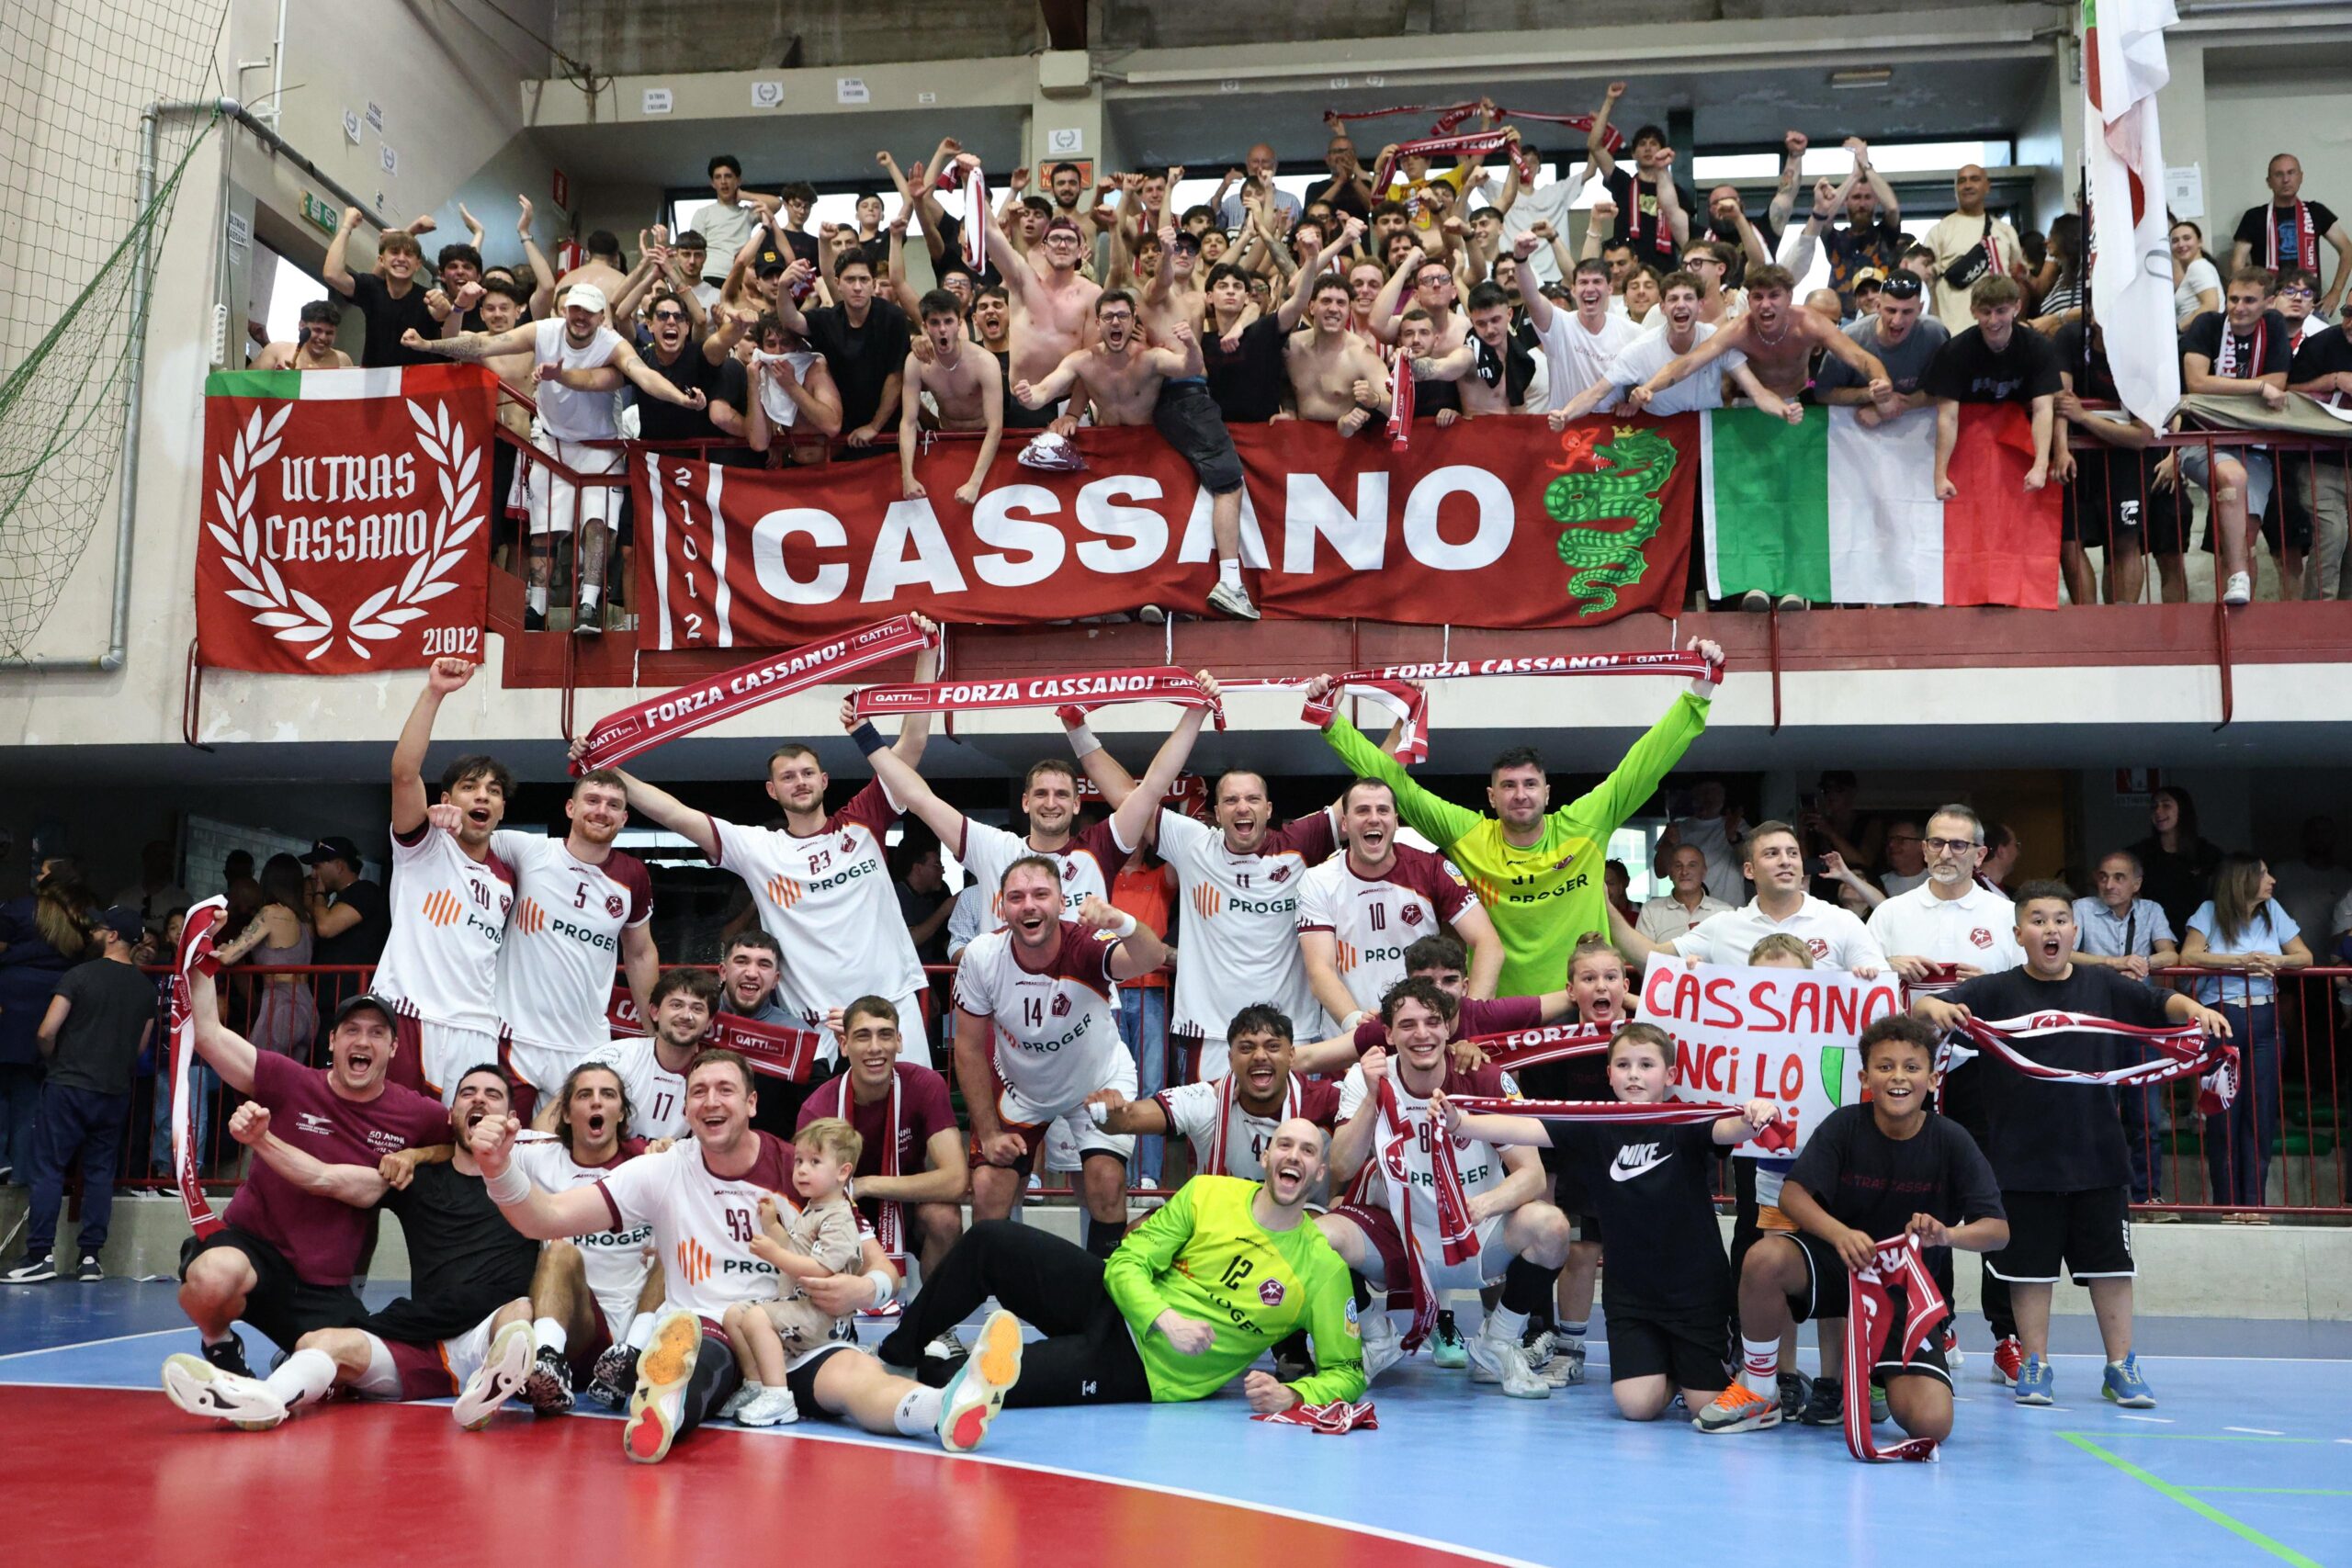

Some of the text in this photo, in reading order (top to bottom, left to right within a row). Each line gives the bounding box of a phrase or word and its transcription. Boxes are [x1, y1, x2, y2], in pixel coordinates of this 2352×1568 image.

[280, 451, 415, 503] ULTRAS
[265, 509, 427, 563] CASSANO
[752, 464, 1516, 604] CASSANO
[422, 626, 480, 656] 21012
[860, 627, 894, 643] GATTI
[1383, 661, 1470, 679] FORZA
[1480, 655, 1620, 674] CASSANO!
[1636, 654, 1679, 663] GATTI
[644, 641, 846, 728] FORZA CASSANO!
[875, 694, 912, 702] GATTI
[937, 683, 1020, 705] FORZA
[1028, 676, 1156, 698] CASSANO!
[588, 728, 623, 751] GATTI
[808, 849, 831, 875] 23
[809, 859, 878, 893] PROGER
[574, 882, 589, 909] 5
[1510, 873, 1589, 903] PROGER
[1368, 902, 1386, 931] 10
[1023, 997, 1043, 1027] 14
[1645, 966, 1896, 1036] CASSANO
[736, 1034, 769, 1049] GATTI
[1022, 1012, 1091, 1053] PROGER
[1507, 1022, 1600, 1051] FORZA
[1755, 1053, 1804, 1102] LO
[652, 1091, 674, 1122] 17
[1618, 1142, 1660, 1166] NIKE
[1410, 1165, 1489, 1187] PRGER
[725, 1208, 754, 1242] 93
[1220, 1255, 1254, 1292] 12
